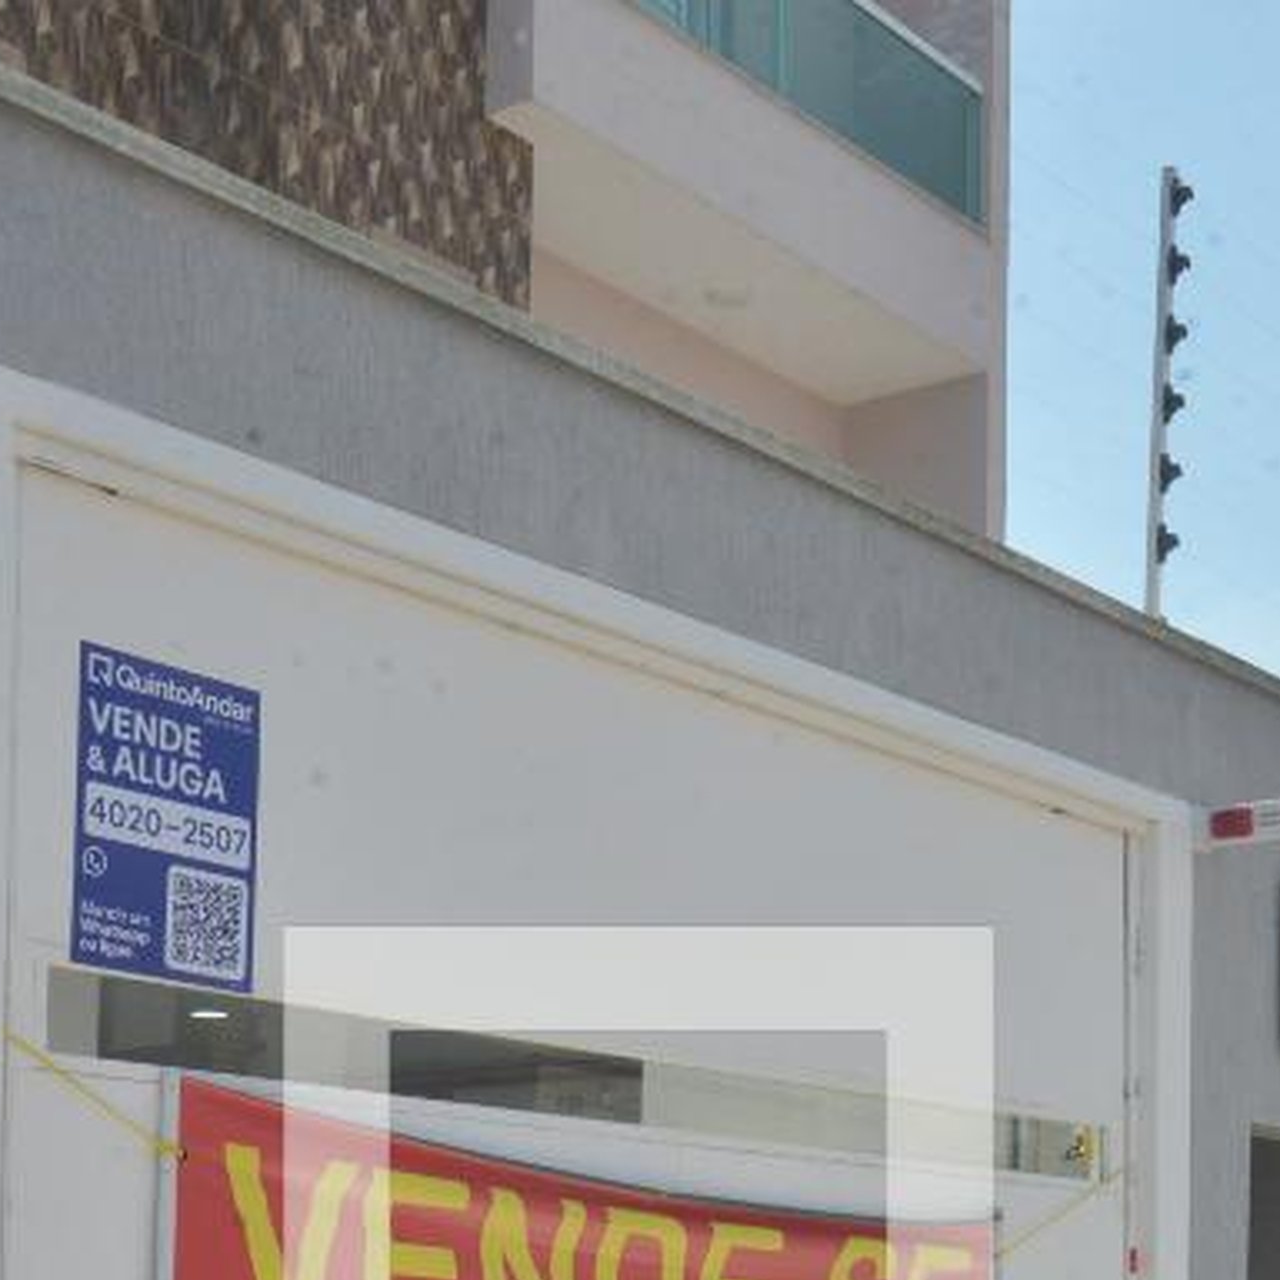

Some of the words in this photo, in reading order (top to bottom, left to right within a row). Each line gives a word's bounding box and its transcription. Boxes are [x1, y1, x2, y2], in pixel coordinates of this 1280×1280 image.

[116, 663, 254, 722] QuintoAndar
[88, 697, 202, 760] VENDE
[86, 745, 108, 773] &
[112, 746, 227, 803] ALUGA
[88, 796, 249, 854] 4020-2507
